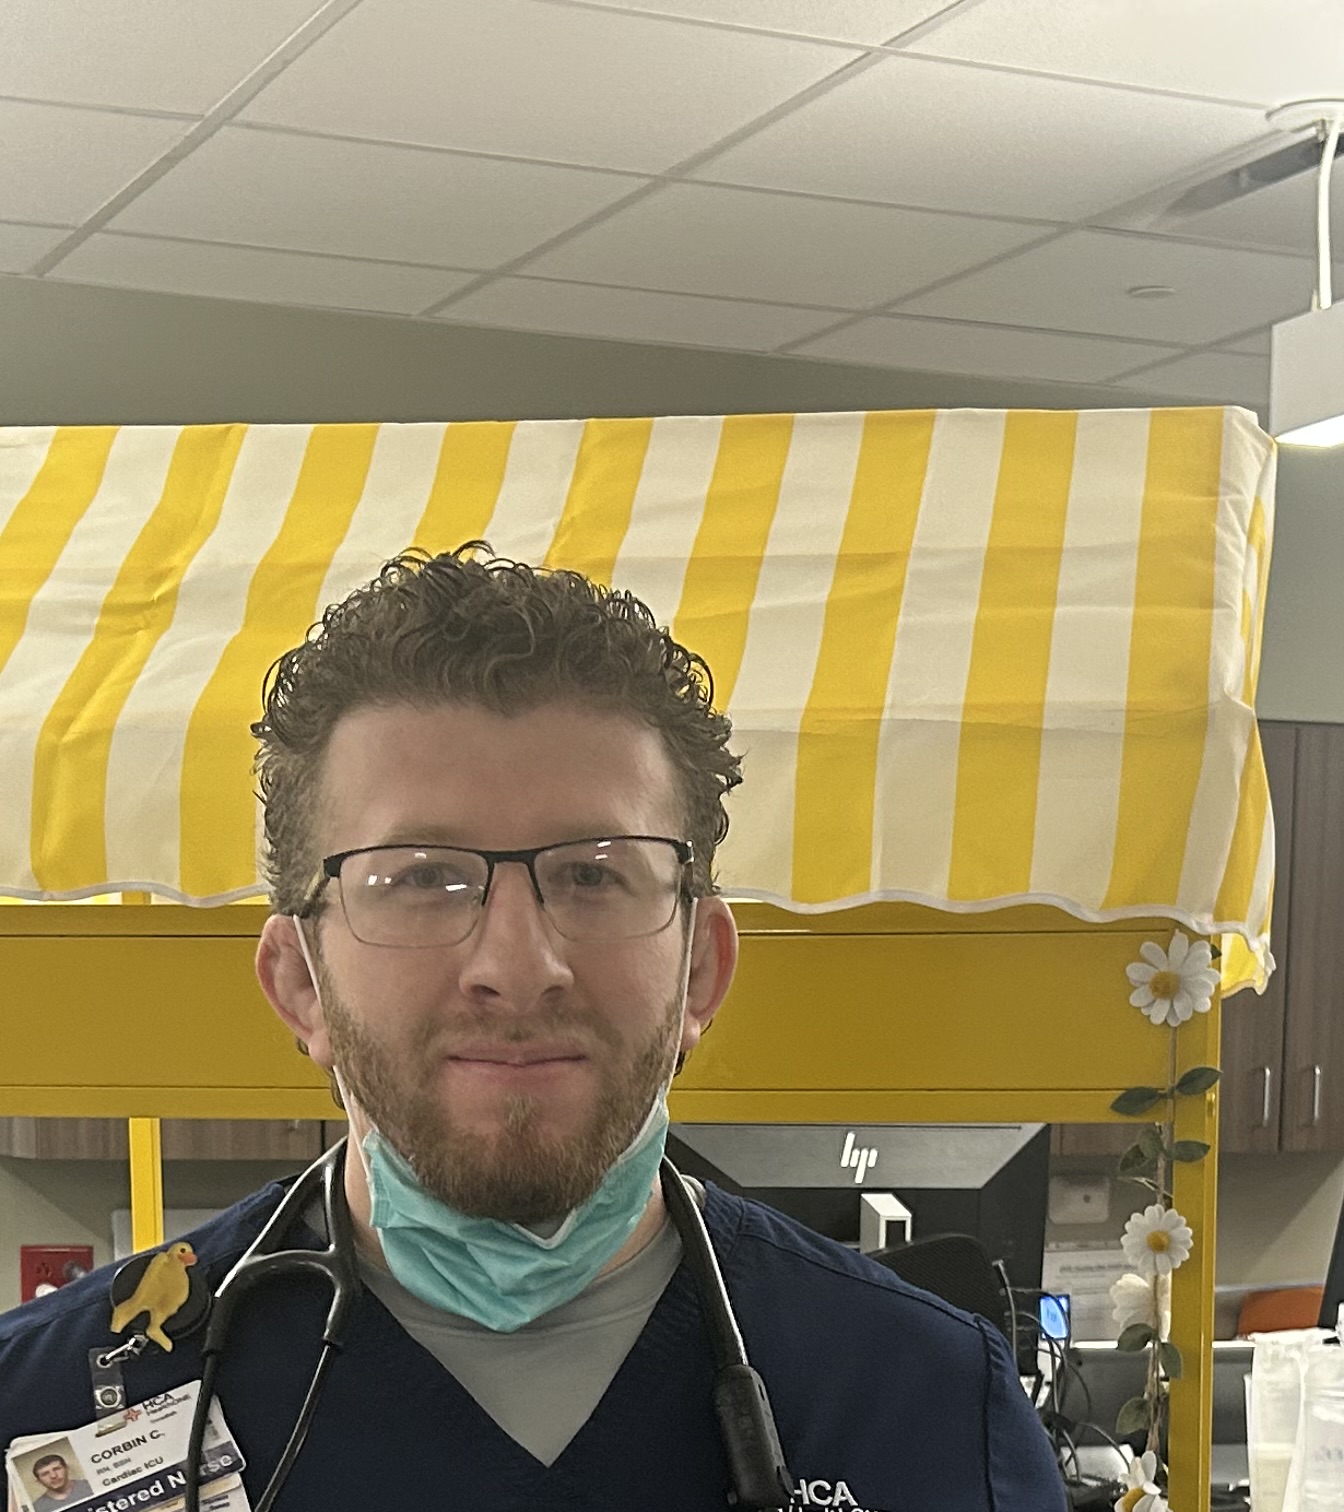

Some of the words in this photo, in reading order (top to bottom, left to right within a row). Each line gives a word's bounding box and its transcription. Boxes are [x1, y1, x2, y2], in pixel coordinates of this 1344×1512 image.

[840, 1132, 878, 1184] hp
[90, 1434, 148, 1464] CORBIN
[102, 1465, 143, 1487] Cardiac
[143, 1456, 164, 1470] ICU
[167, 1454, 234, 1489] Nrse
[790, 1478, 858, 1507] HCA
